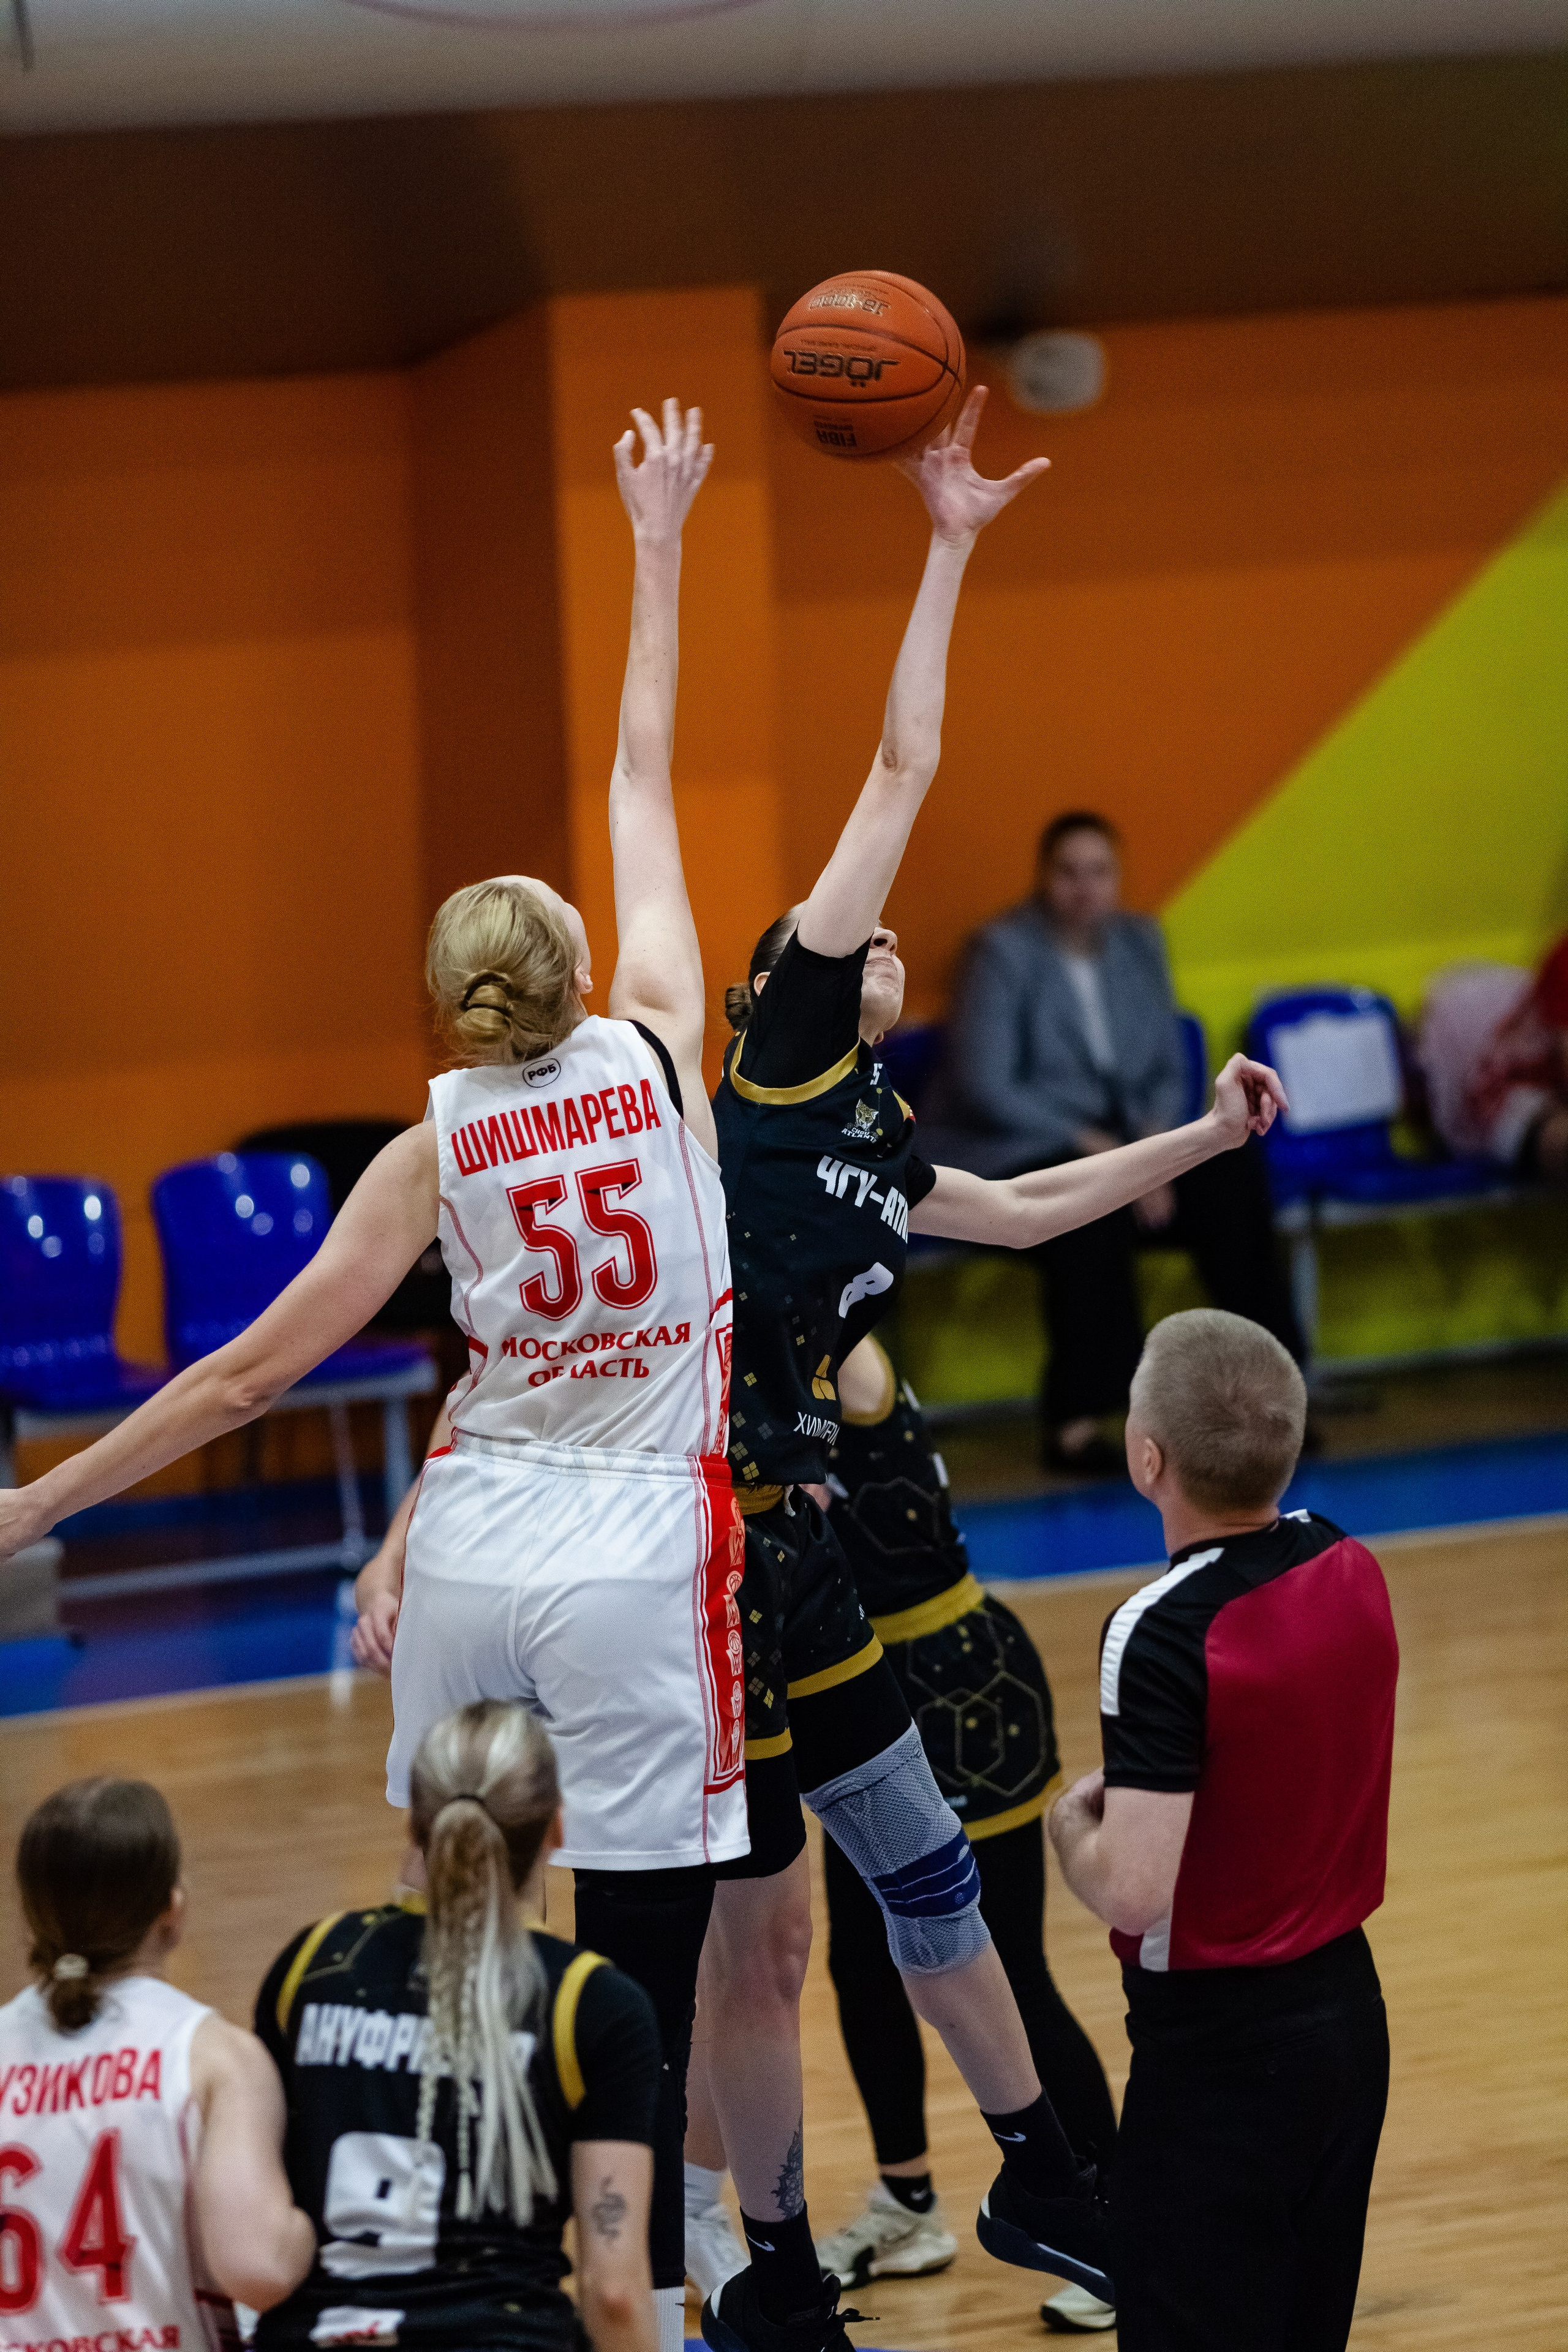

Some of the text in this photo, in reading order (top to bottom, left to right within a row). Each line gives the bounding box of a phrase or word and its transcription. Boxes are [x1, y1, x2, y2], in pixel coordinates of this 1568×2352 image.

[783, 350, 902, 388] JÖGEL
[528, 1063, 556, 1080] РФБ
[451, 1079, 662, 1177] ШИШМАРЕВА
[506, 1158, 658, 1321] 55
[816, 1155, 908, 1245] ЧГУ-АТЛ
